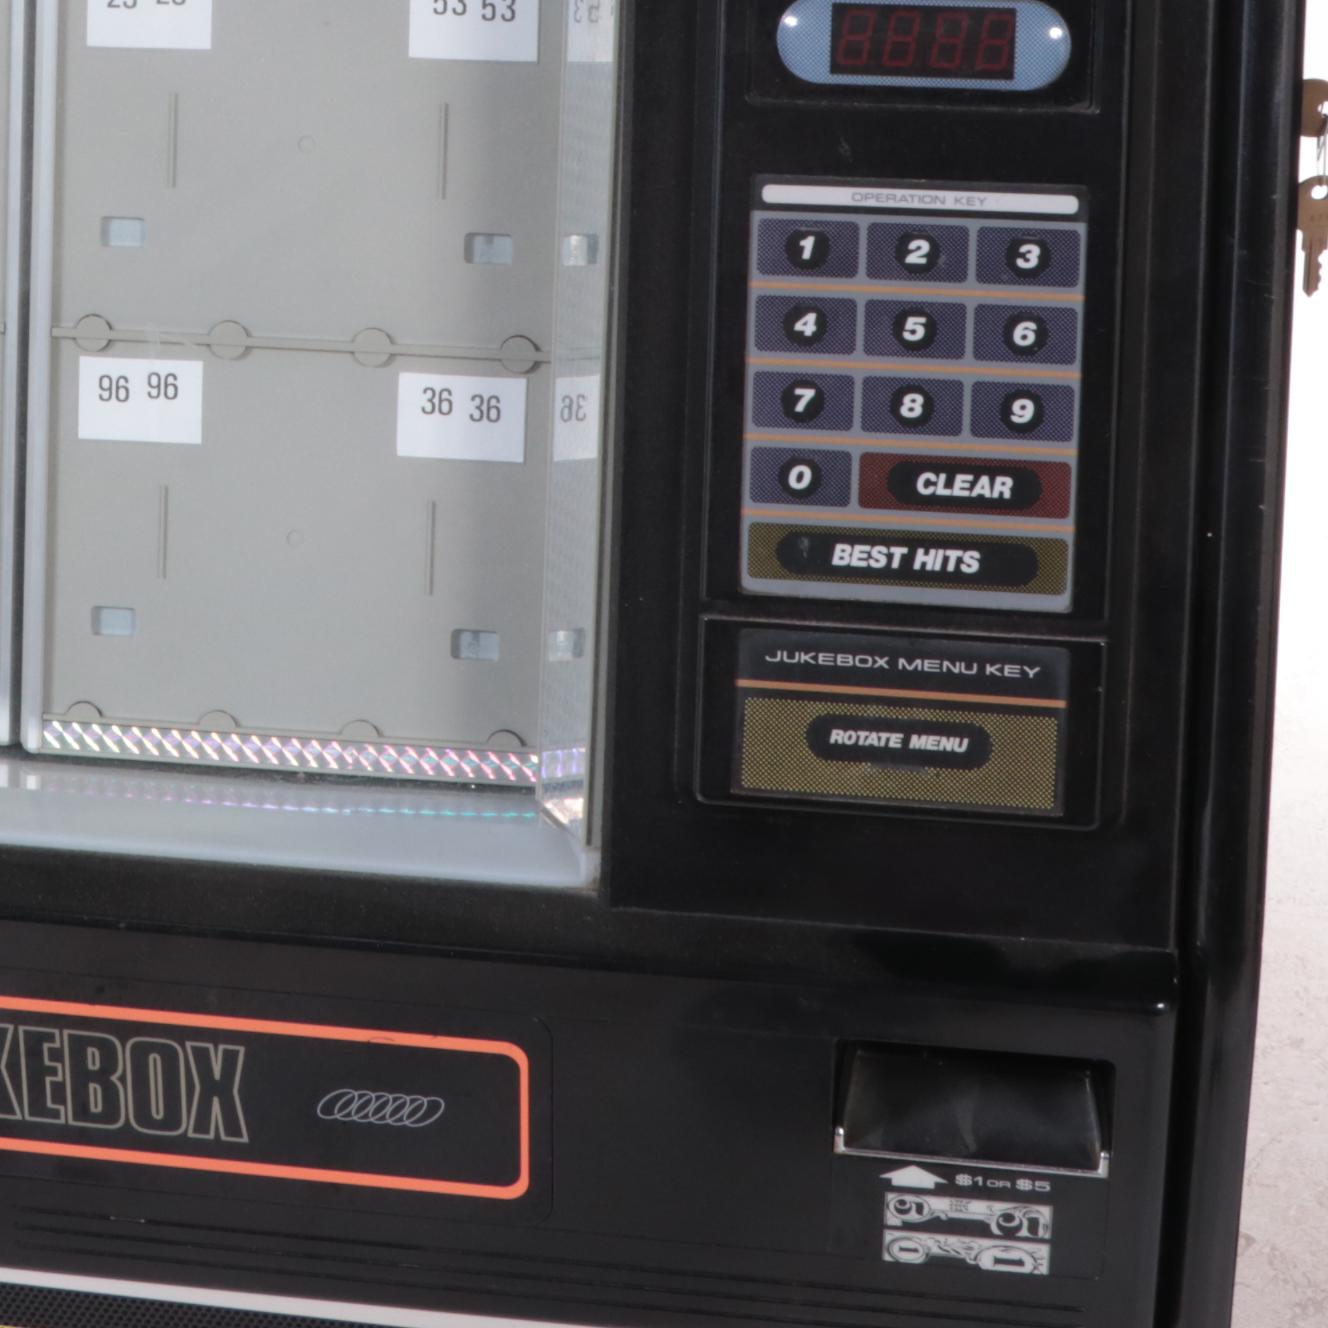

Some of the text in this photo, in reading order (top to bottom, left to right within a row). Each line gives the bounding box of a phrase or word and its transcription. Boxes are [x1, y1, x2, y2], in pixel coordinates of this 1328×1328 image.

[851, 191, 987, 207] OPERATION KEY
[799, 236, 816, 260] 1
[904, 239, 931, 264] 2
[1015, 244, 1041, 269] 3
[794, 312, 818, 337] 4
[902, 316, 927, 341] 5
[1013, 321, 1038, 347] 6
[99, 372, 178, 403] 96 96
[421, 387, 501, 423] 36 36
[793, 388, 816, 413] 7
[900, 393, 925, 418] 8
[1010, 398, 1036, 424] 9
[788, 464, 813, 490] 0
[916, 471, 1014, 499] CLEAR
[831, 543, 981, 574] BEST HITS
[765, 650, 1041, 679] JUKEBOX MENU KEY
[829, 729, 969, 753] ROTATE MENU
[955, 1173, 1051, 1192] $1 OR $5
